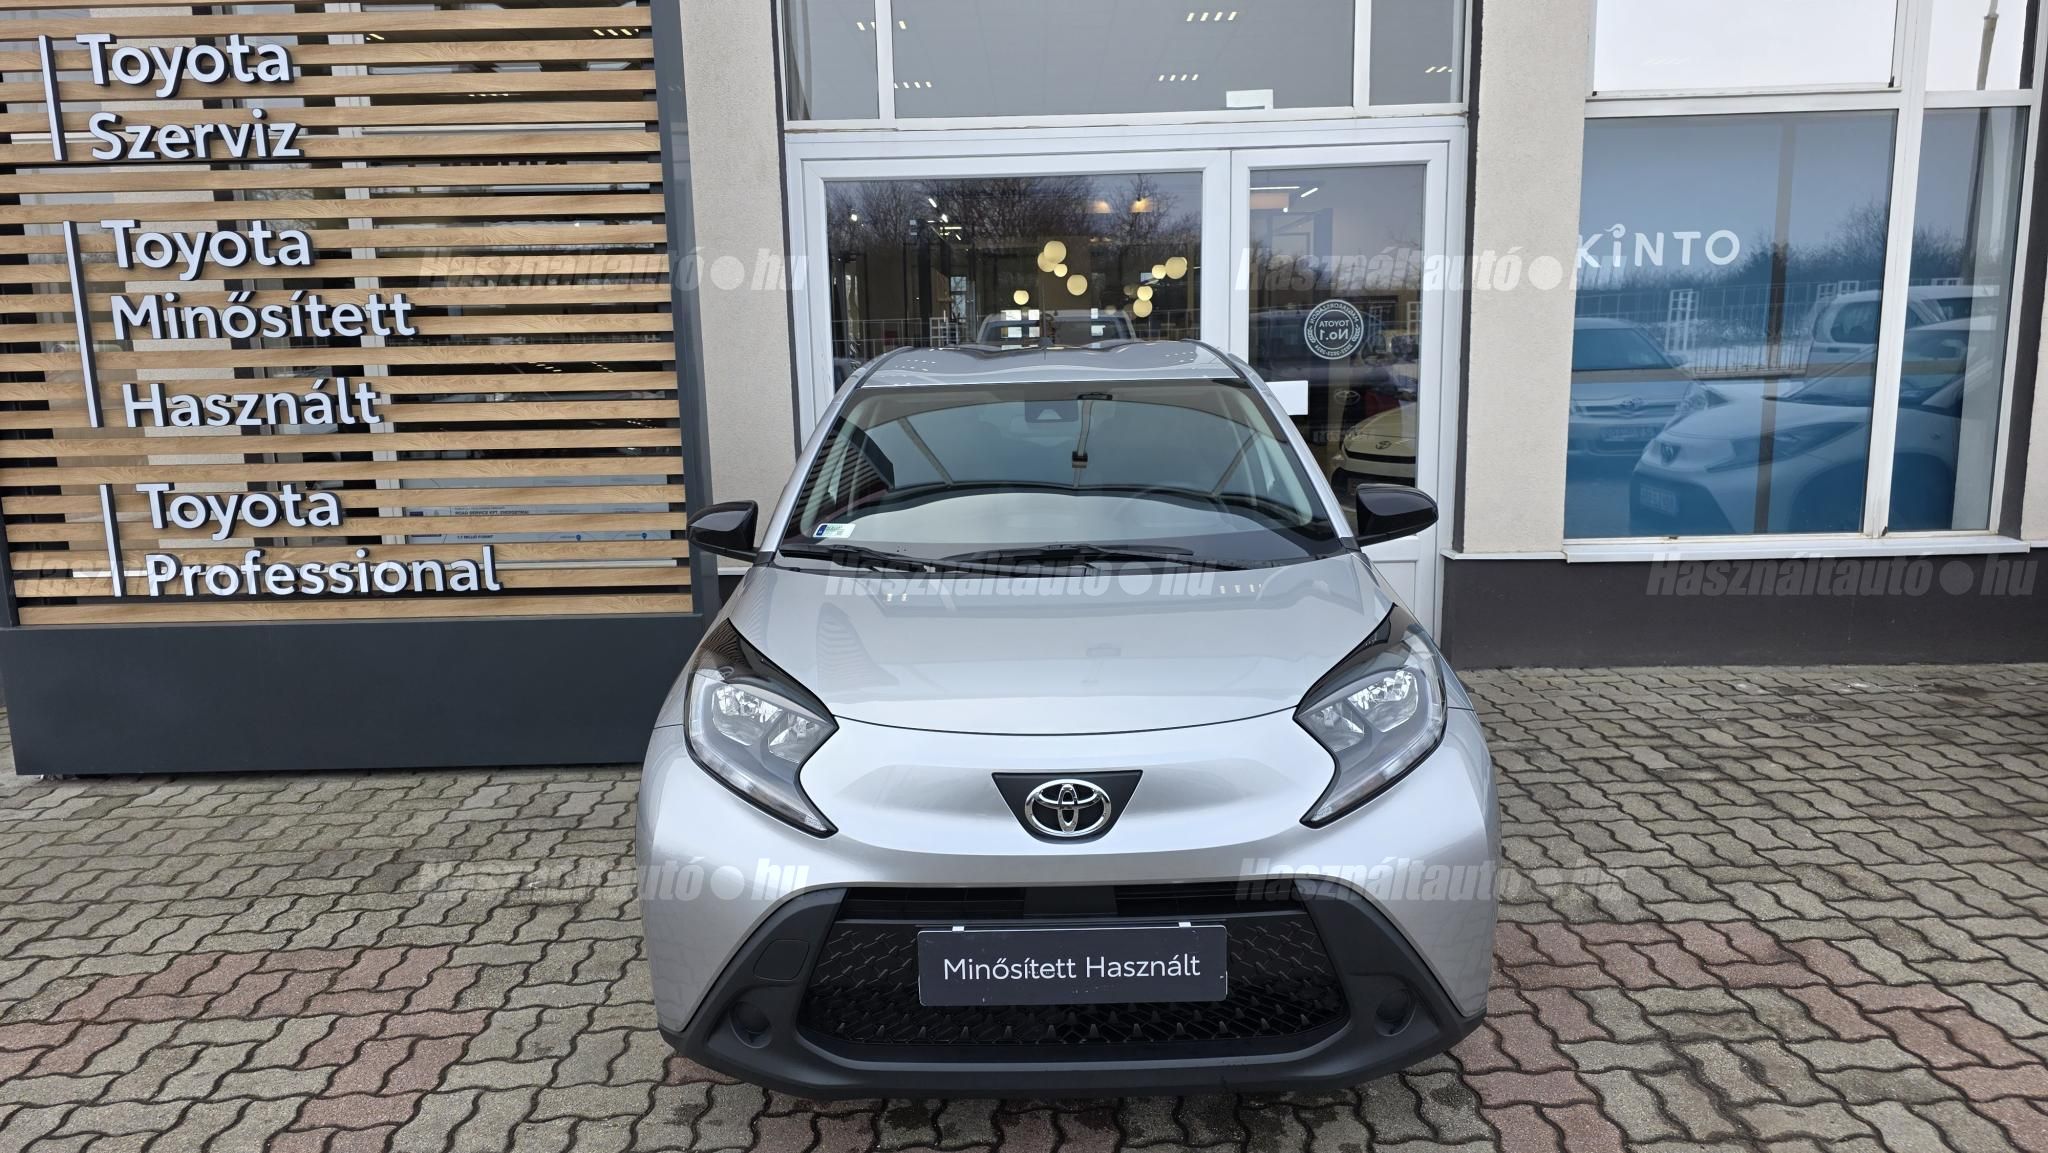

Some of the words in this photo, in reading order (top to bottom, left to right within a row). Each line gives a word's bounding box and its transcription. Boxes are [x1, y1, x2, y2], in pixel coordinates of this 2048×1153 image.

[76, 33, 292, 98] Toyota
[88, 108, 301, 161] Szerviz
[101, 219, 313, 282] Toyota
[110, 291, 418, 341] Minősített
[121, 376, 381, 429] Használt
[135, 482, 341, 541] Toyota
[144, 544, 502, 598] Professional
[943, 957, 1077, 980] Minősített
[1086, 953, 1201, 978] Használt
